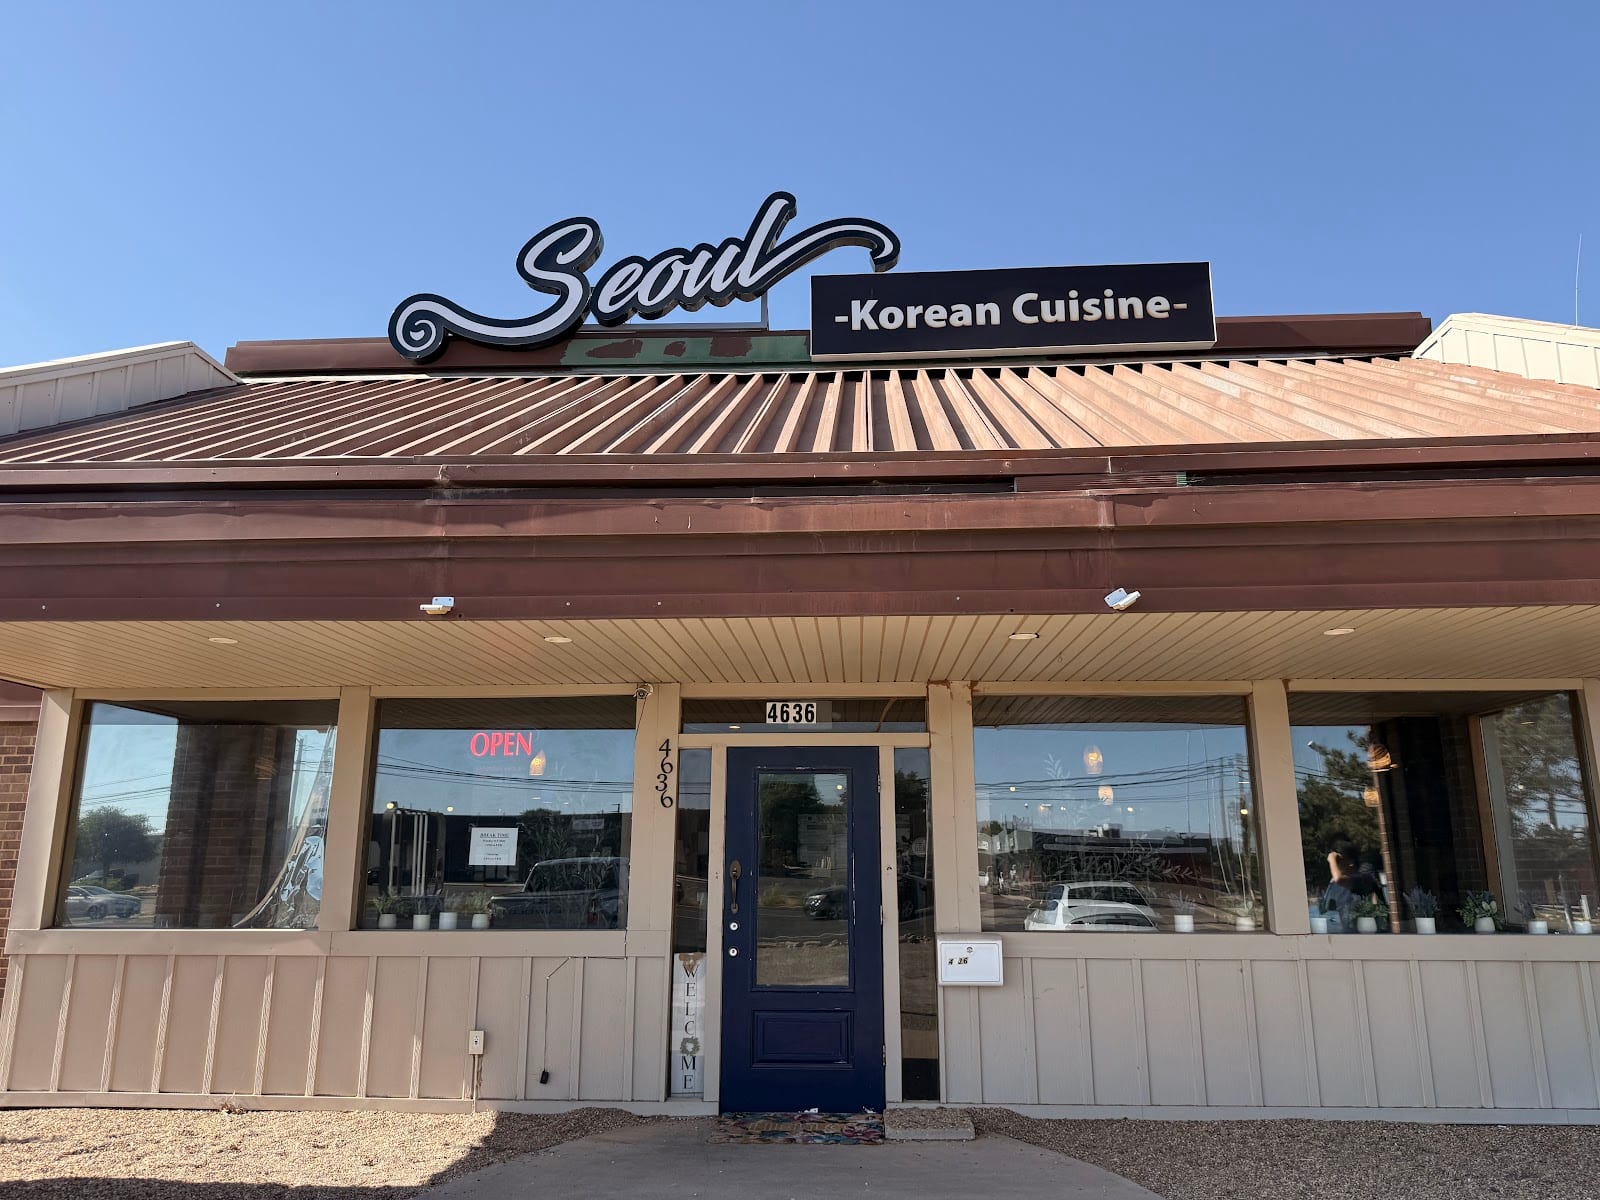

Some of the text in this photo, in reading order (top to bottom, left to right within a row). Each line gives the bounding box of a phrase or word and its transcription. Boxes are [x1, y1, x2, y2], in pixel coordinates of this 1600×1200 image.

[391, 193, 899, 357] Seoul
[767, 703, 815, 723] 4636
[470, 731, 533, 757] OPEN
[655, 738, 674, 809] 4636
